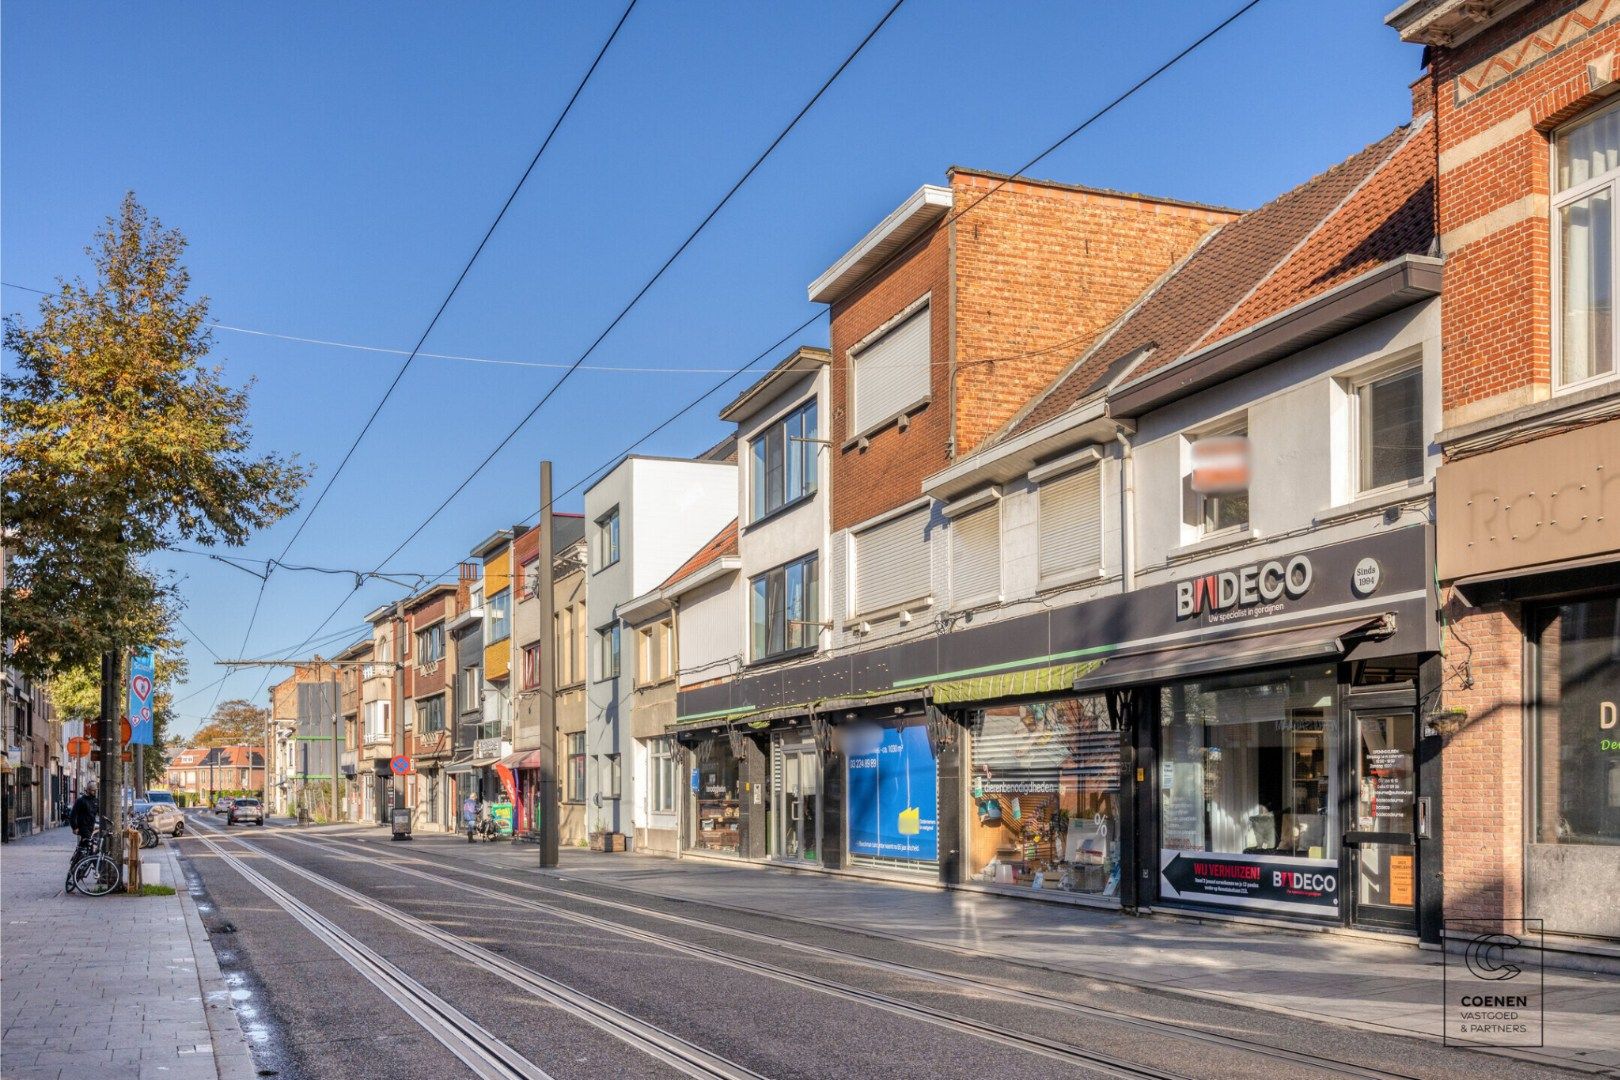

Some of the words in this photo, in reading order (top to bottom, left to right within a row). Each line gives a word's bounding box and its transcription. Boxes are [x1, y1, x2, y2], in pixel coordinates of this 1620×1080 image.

[1356, 566, 1376, 577] Sinds
[1208, 613, 1219, 623] Uw
[1220, 607, 1247, 621] specialist
[1248, 608, 1253, 616] in
[1254, 603, 1284, 618] gordijnen
[1600, 740, 1620, 751] De
[1194, 863, 1208, 875] WIJ
[1208, 864, 1261, 880] VERHUIZEN!
